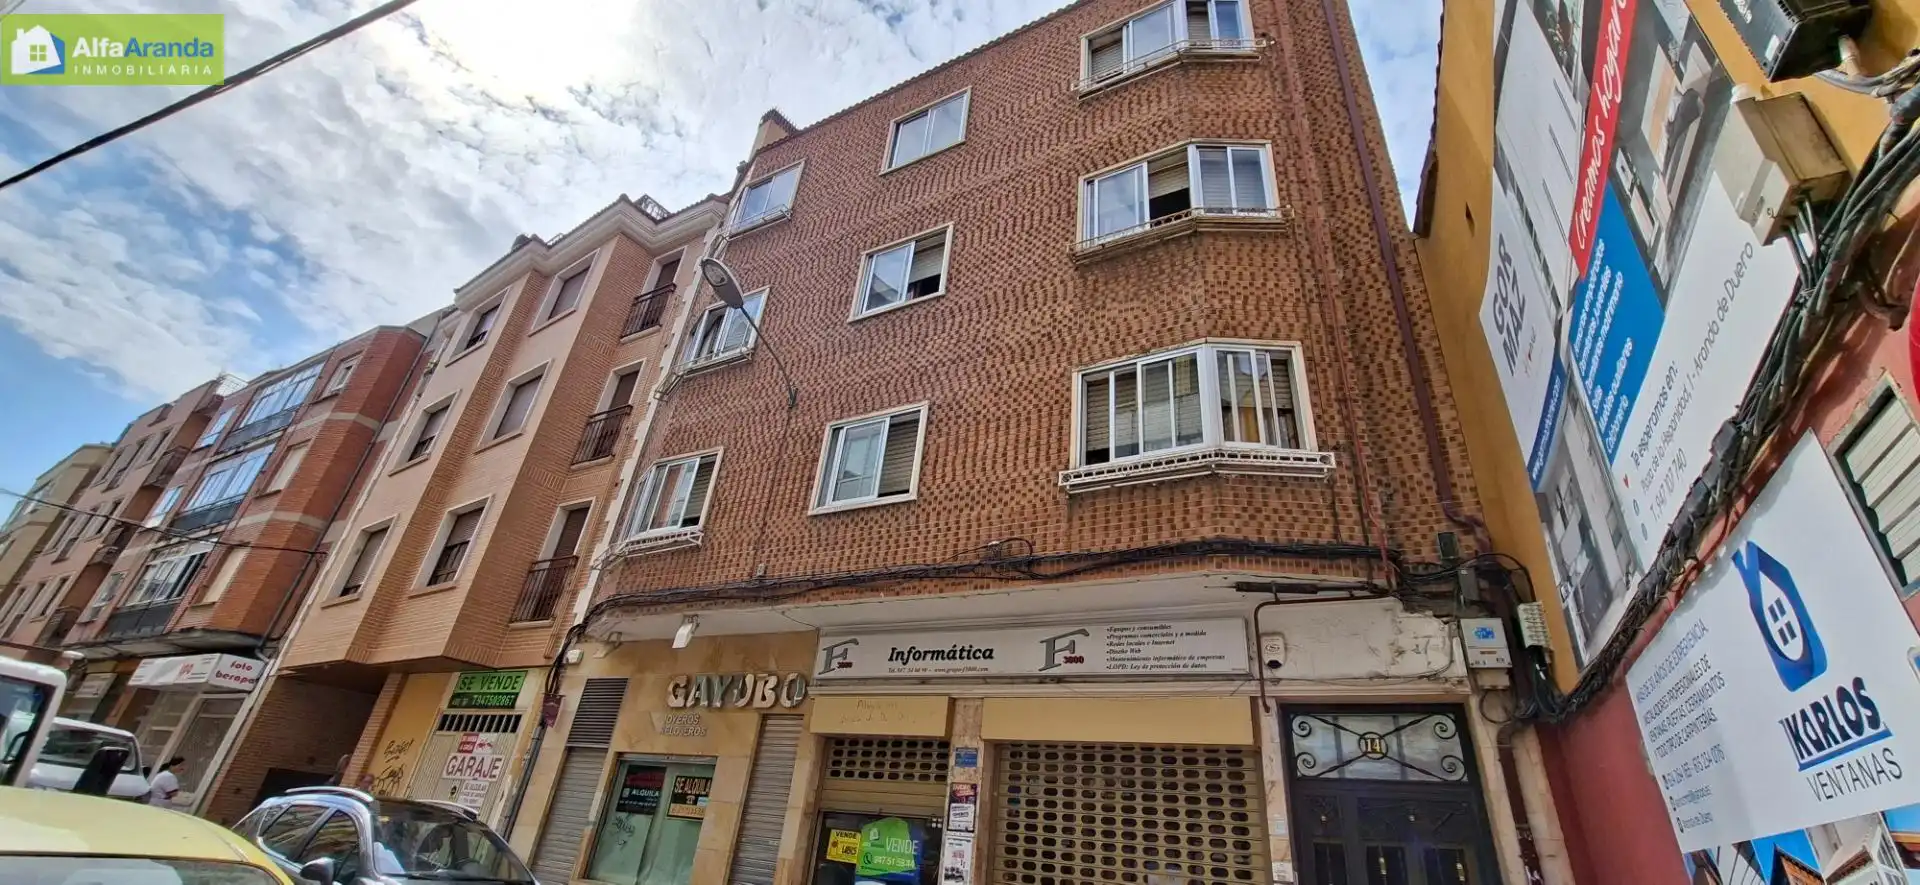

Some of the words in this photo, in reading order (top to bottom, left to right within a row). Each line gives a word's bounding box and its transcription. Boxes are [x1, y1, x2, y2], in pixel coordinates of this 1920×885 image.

[1575, 115, 1606, 250] Creamos
[1492, 232, 1513, 336] GOR
[1502, 265, 1526, 377] MAZ
[1693, 319, 1720, 376] Aranda
[1716, 296, 1729, 323] de
[1723, 242, 1753, 302] Duero
[1637, 386, 1668, 453] esperamos
[1665, 360, 1679, 391] en:
[818, 638, 860, 675] F
[888, 644, 995, 666] Informática
[1038, 628, 1090, 672] F
[1671, 618, 1709, 666] EXPERIENCIA
[230, 660, 253, 671] foto
[460, 676, 476, 691] SE
[480, 675, 521, 691] VENDE
[667, 672, 807, 709] GAYUBO
[1685, 671, 1726, 713] CERRAMIENTOS
[1365, 738, 1381, 753] 14
[446, 755, 502, 779] GARAJE
[1806, 748, 1903, 802] VENTANAS
[631, 789, 660, 797] ALQUILA
[674, 777, 685, 794] SE
[685, 777, 712, 795] ALQUILA
[835, 831, 857, 840] VENDE
[886, 837, 919, 855] VENDE
